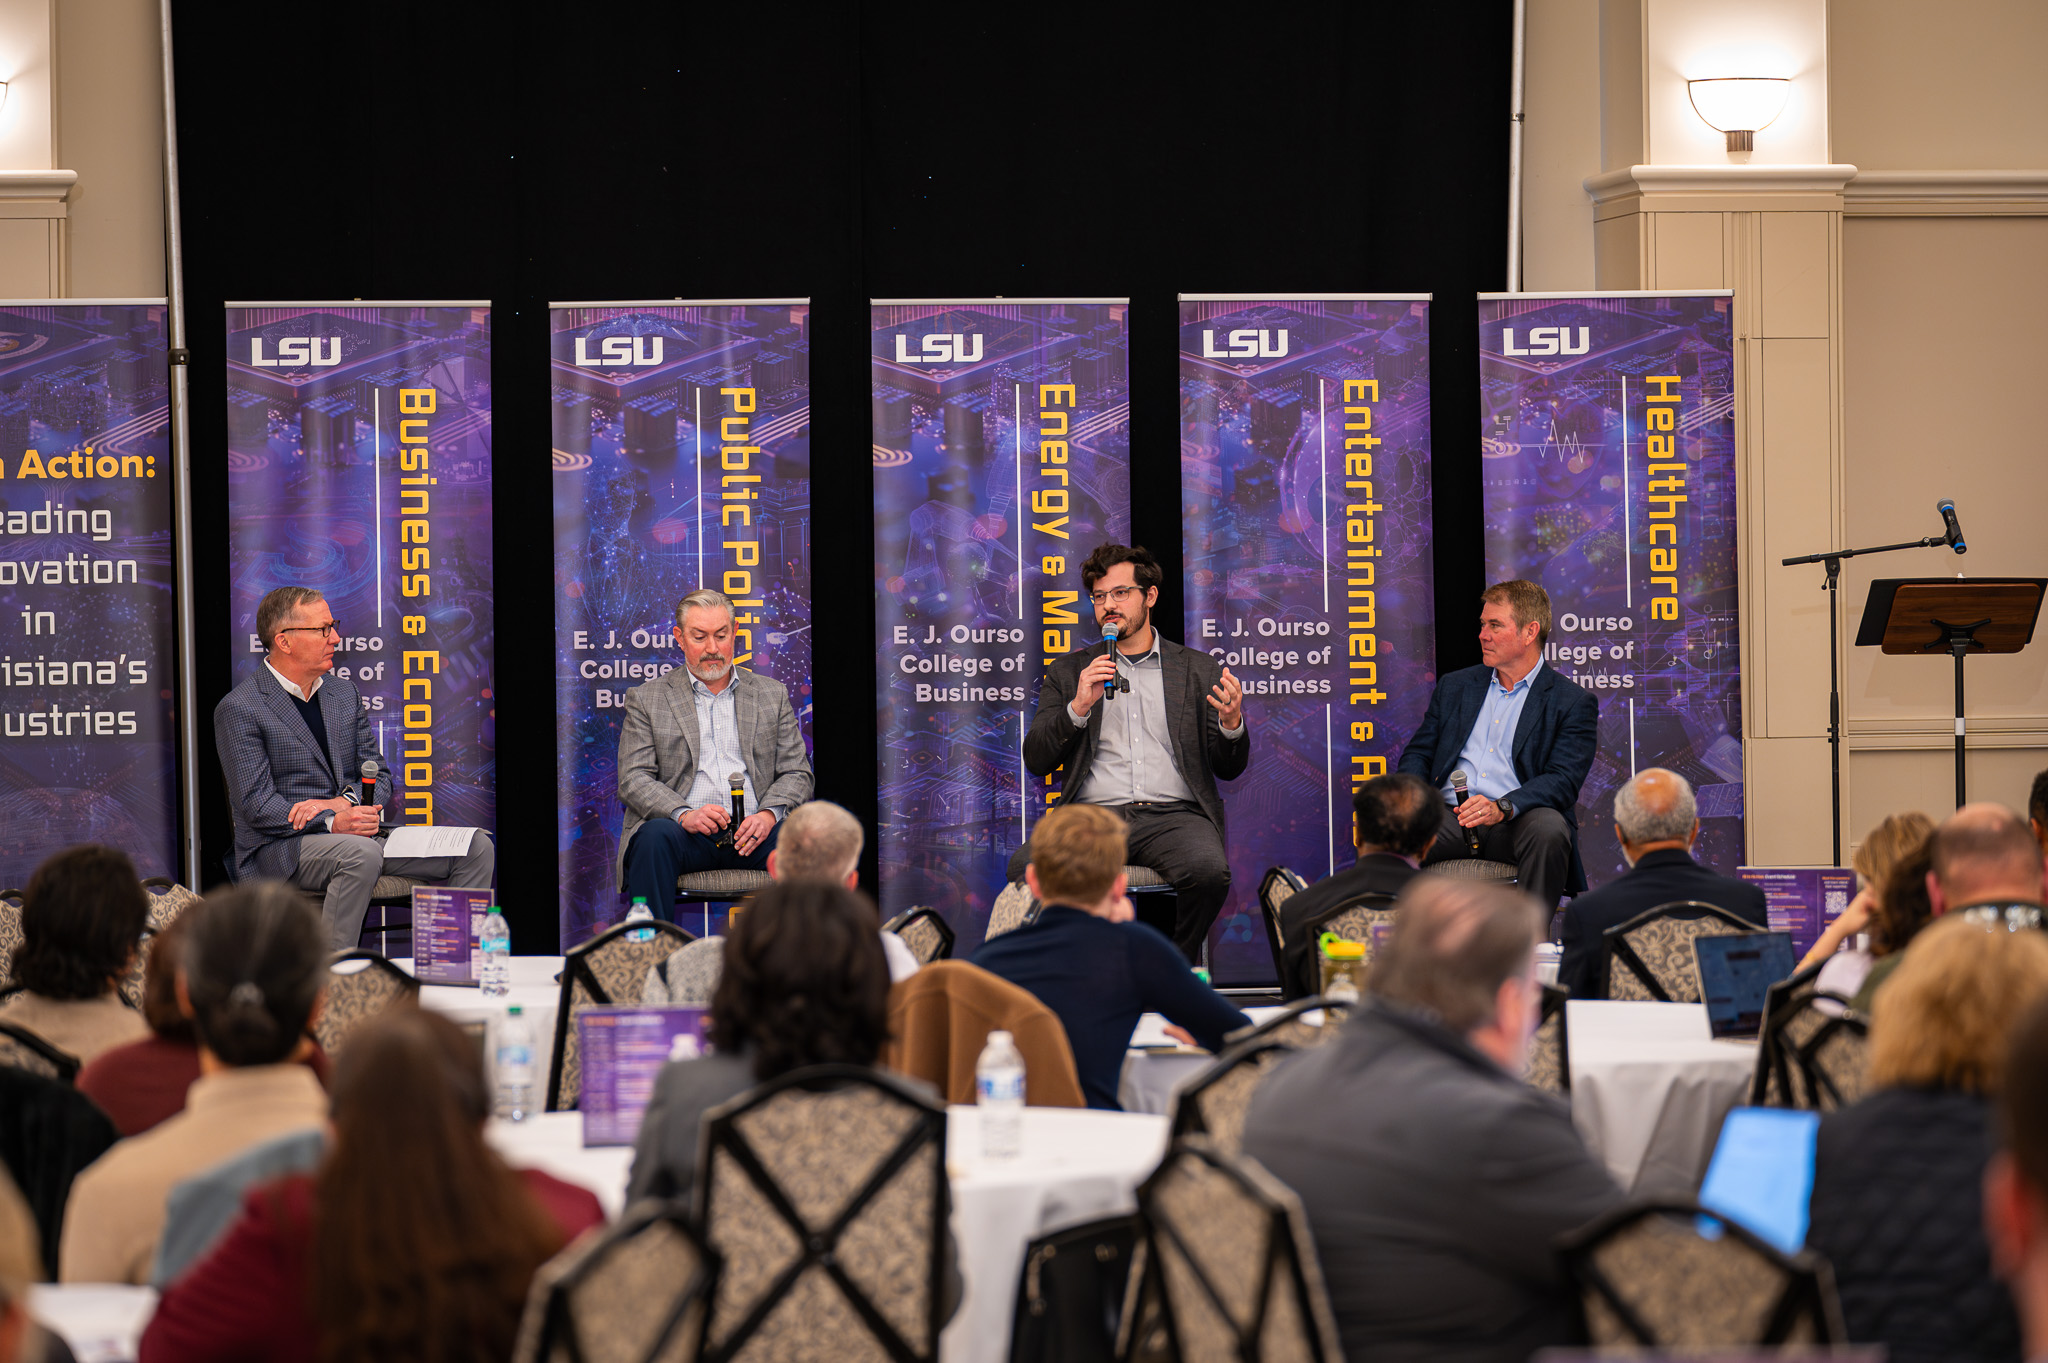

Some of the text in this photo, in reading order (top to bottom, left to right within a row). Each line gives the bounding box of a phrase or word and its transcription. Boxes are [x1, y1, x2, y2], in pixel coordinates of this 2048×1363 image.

[252, 337, 342, 367] LSU
[575, 336, 664, 366] LSU
[895, 334, 984, 363] LSU
[1203, 329, 1289, 358] LSU
[1503, 327, 1590, 356] LSU
[17, 447, 156, 479] Action:
[720, 388, 762, 527] Public
[1032, 384, 1076, 539] Energy
[1646, 376, 1688, 620] Healthcare
[0, 501, 112, 541] ading
[1344, 380, 1387, 704] Entertainment
[0, 553, 138, 585] ovation
[1042, 556, 1066, 576] &
[21, 605, 55, 635] in
[400, 389, 440, 827] Business & Econom
[1560, 613, 1633, 632] Ourso
[573, 628, 682, 650] E. J. Our
[893, 624, 1024, 645] E. J. Ourso
[1202, 617, 1330, 638] E. J. Ourso
[900, 653, 1026, 678] College of
[1209, 646, 1331, 670] College of
[1545, 641, 1634, 665] llege of
[1, 654, 148, 686] isiana's
[359, 662, 385, 681] of
[580, 660, 674, 684] College
[1566, 669, 1635, 689] iness
[916, 682, 1025, 702] Business
[1236, 675, 1332, 695] usiness
[4, 704, 137, 736] ustries
[1351, 721, 1374, 741] &
